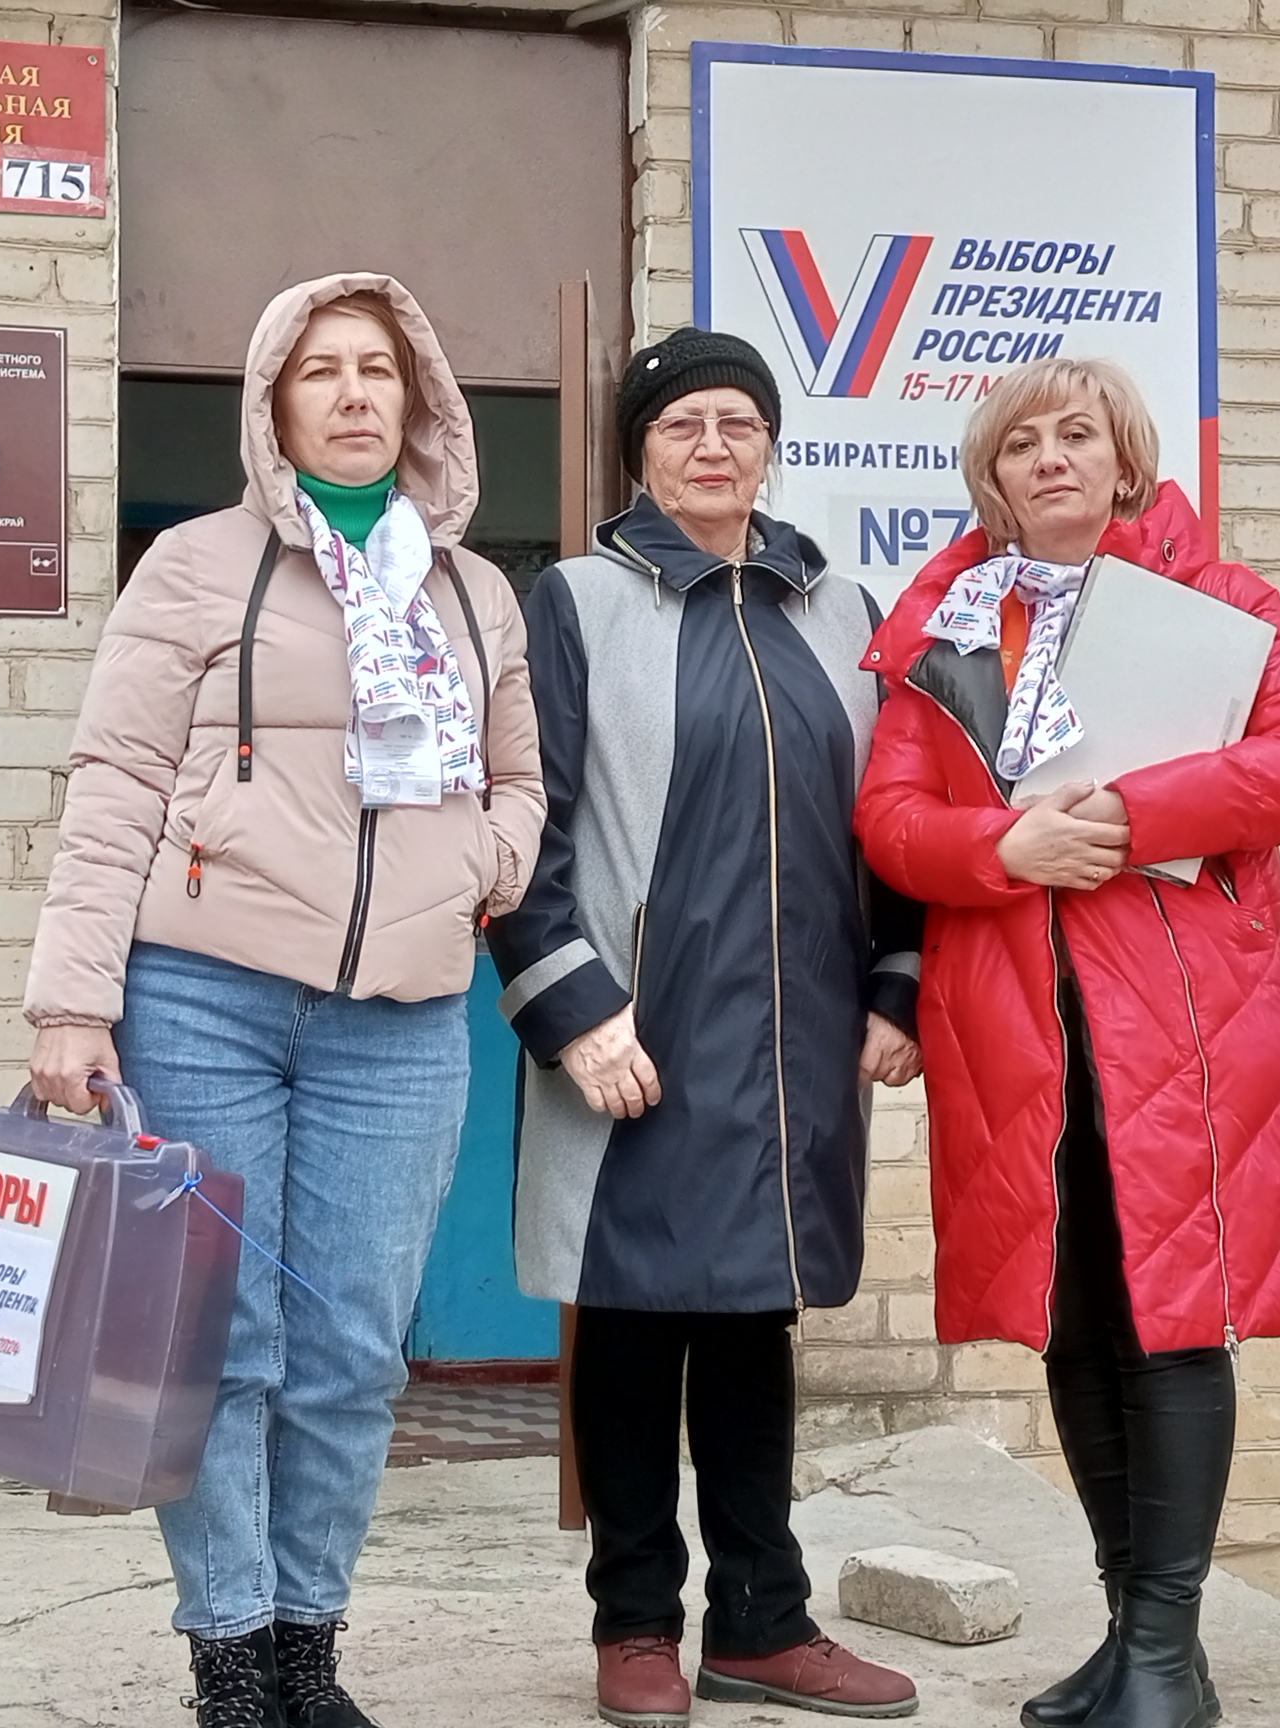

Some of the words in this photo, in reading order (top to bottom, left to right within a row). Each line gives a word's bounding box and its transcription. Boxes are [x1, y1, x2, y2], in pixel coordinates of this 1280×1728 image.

[950, 238, 1116, 275] ВЫБОРЫ
[931, 284, 1162, 324] ПРЕЗИДЕНТА
[912, 329, 1064, 363] РОССИИ
